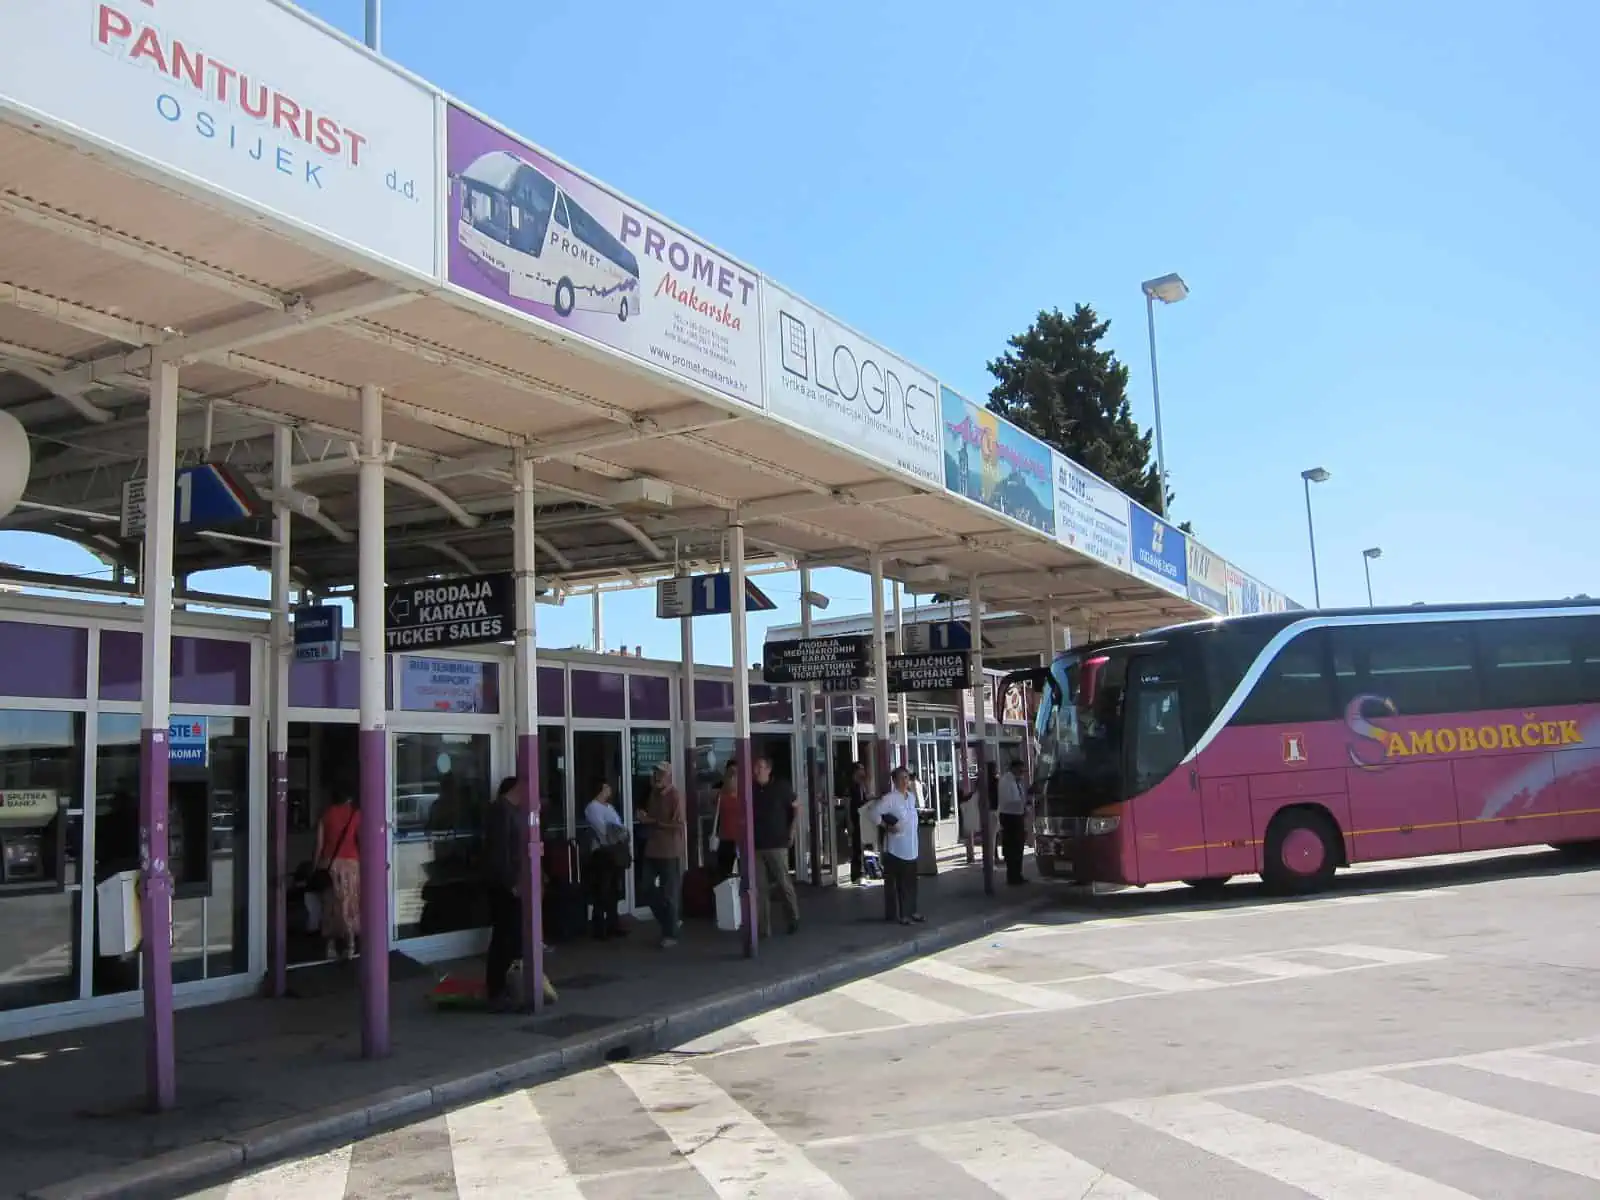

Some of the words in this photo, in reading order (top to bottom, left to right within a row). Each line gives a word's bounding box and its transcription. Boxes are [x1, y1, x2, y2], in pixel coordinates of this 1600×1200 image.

[98, 5, 366, 166] PANTURIST
[156, 93, 324, 190] OSIJEK
[550, 231, 601, 269] PROMET
[619, 211, 755, 306] PROMET
[654, 271, 742, 331] Makarska
[177, 471, 193, 523] 1
[414, 580, 493, 607] PRODAJA
[703, 577, 716, 610] 1
[419, 600, 488, 624] KARATA
[387, 626, 445, 646] TICKET
[449, 619, 503, 640] SALES
[799, 639, 840, 649] PRODAJA
[938, 623, 949, 649] 1
[788, 662, 857, 673] INTERNATIONAL
[801, 654, 837, 663] KARATA
[793, 670, 823, 680] TICKET
[902, 667, 965, 680] EXCHANGE
[912, 677, 954, 689] OFFICE
[1345, 693, 1584, 773] SAMOBORČEK
